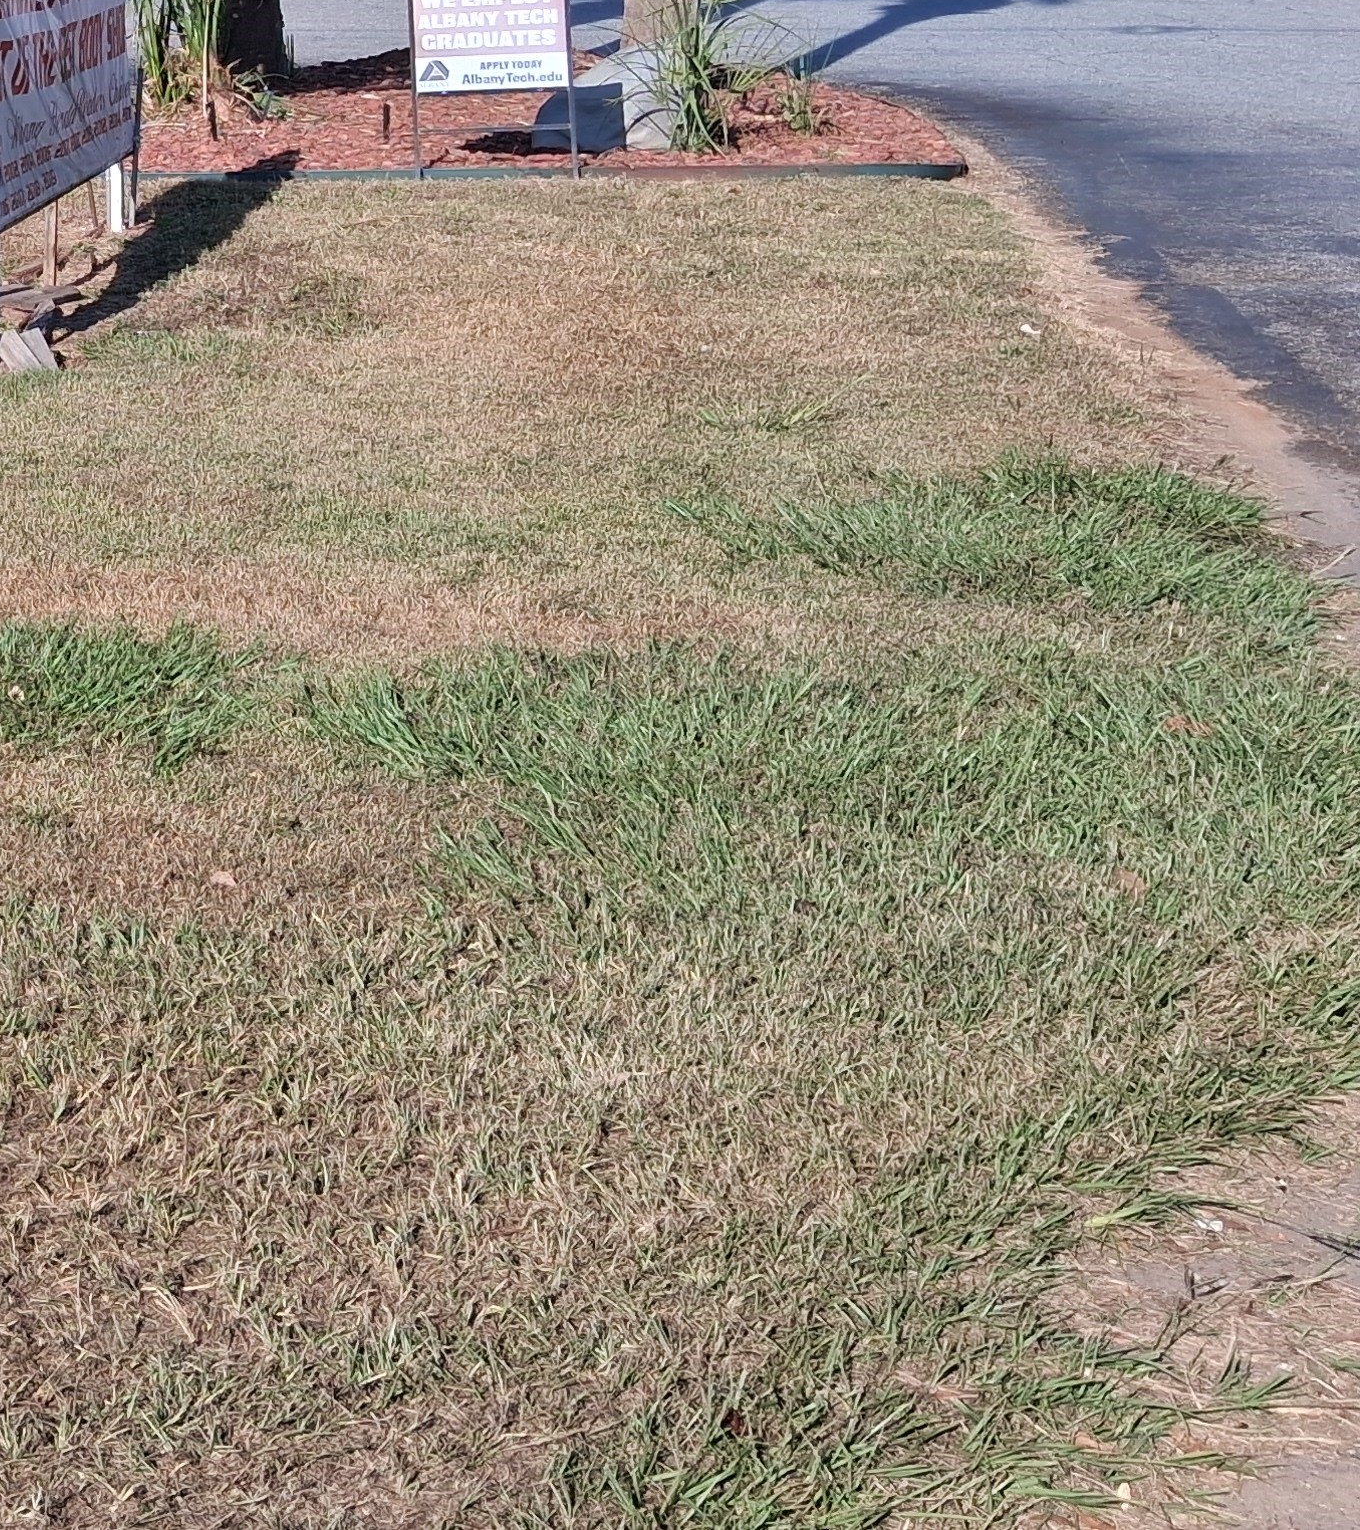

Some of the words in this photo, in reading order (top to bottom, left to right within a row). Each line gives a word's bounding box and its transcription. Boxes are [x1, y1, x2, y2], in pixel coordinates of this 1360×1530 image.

[418, 11, 501, 30] ALBANY
[504, 8, 559, 25] TECH
[421, 29, 556, 50] GRADUATES
[480, 61, 509, 70] APPLY
[512, 60, 542, 69] TODAY
[462, 71, 563, 85] AlbanyTech.edu
